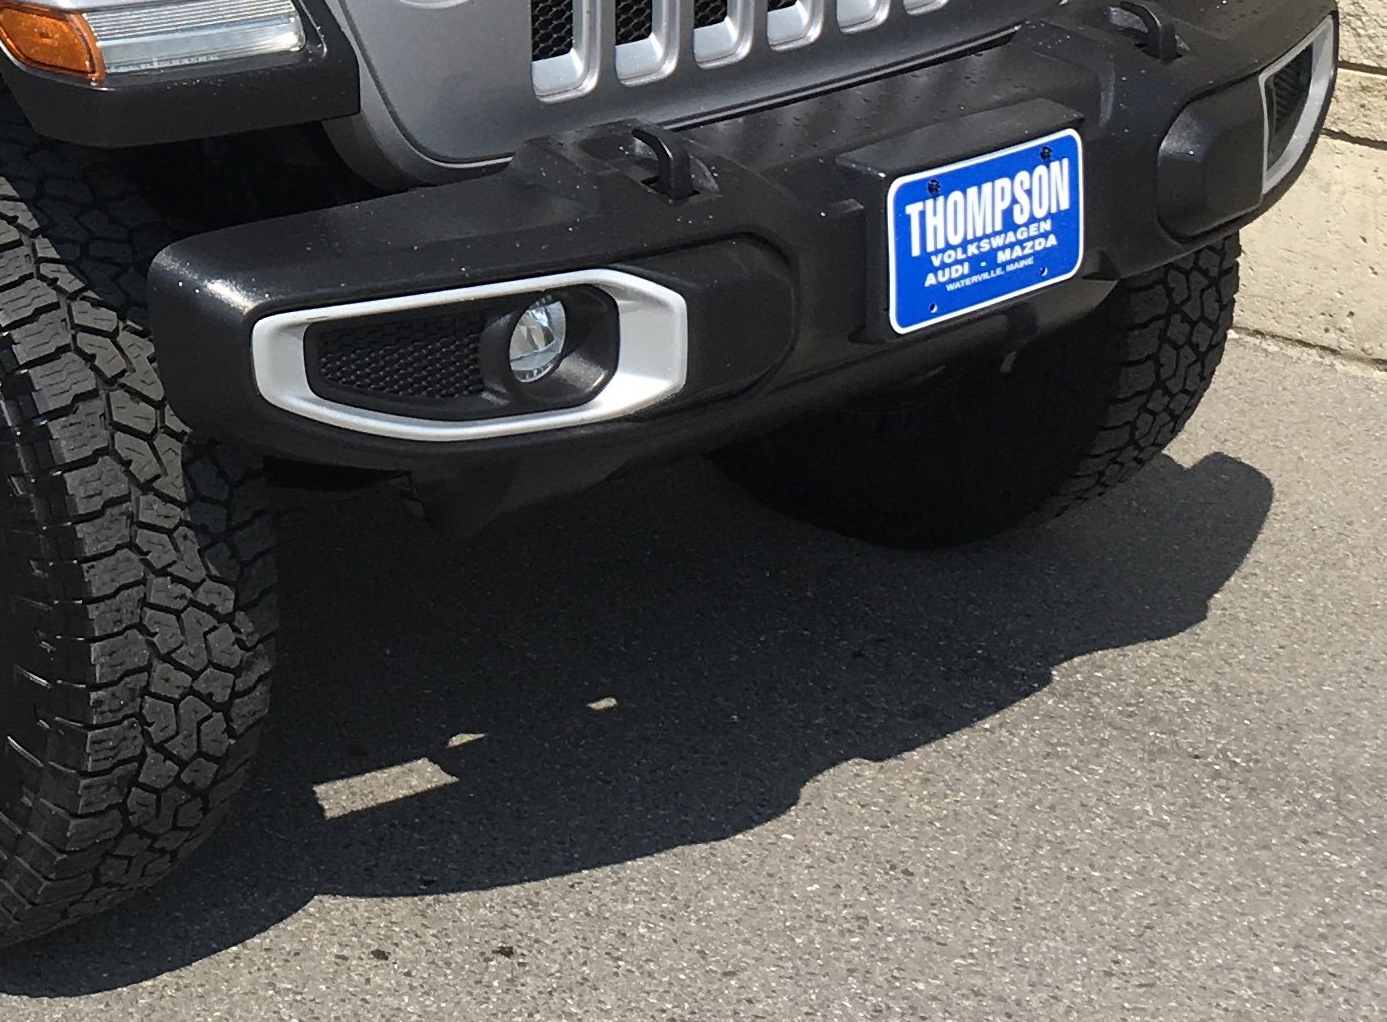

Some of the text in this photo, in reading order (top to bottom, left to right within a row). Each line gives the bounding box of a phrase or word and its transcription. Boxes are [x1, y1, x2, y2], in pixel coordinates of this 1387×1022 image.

[905, 157, 1071, 258] THOMPSON
[924, 233, 1058, 288] AUDI MAZDA
[930, 219, 1052, 267] VOLKSWAGEN
[1005, 255, 1034, 273] MAINE
